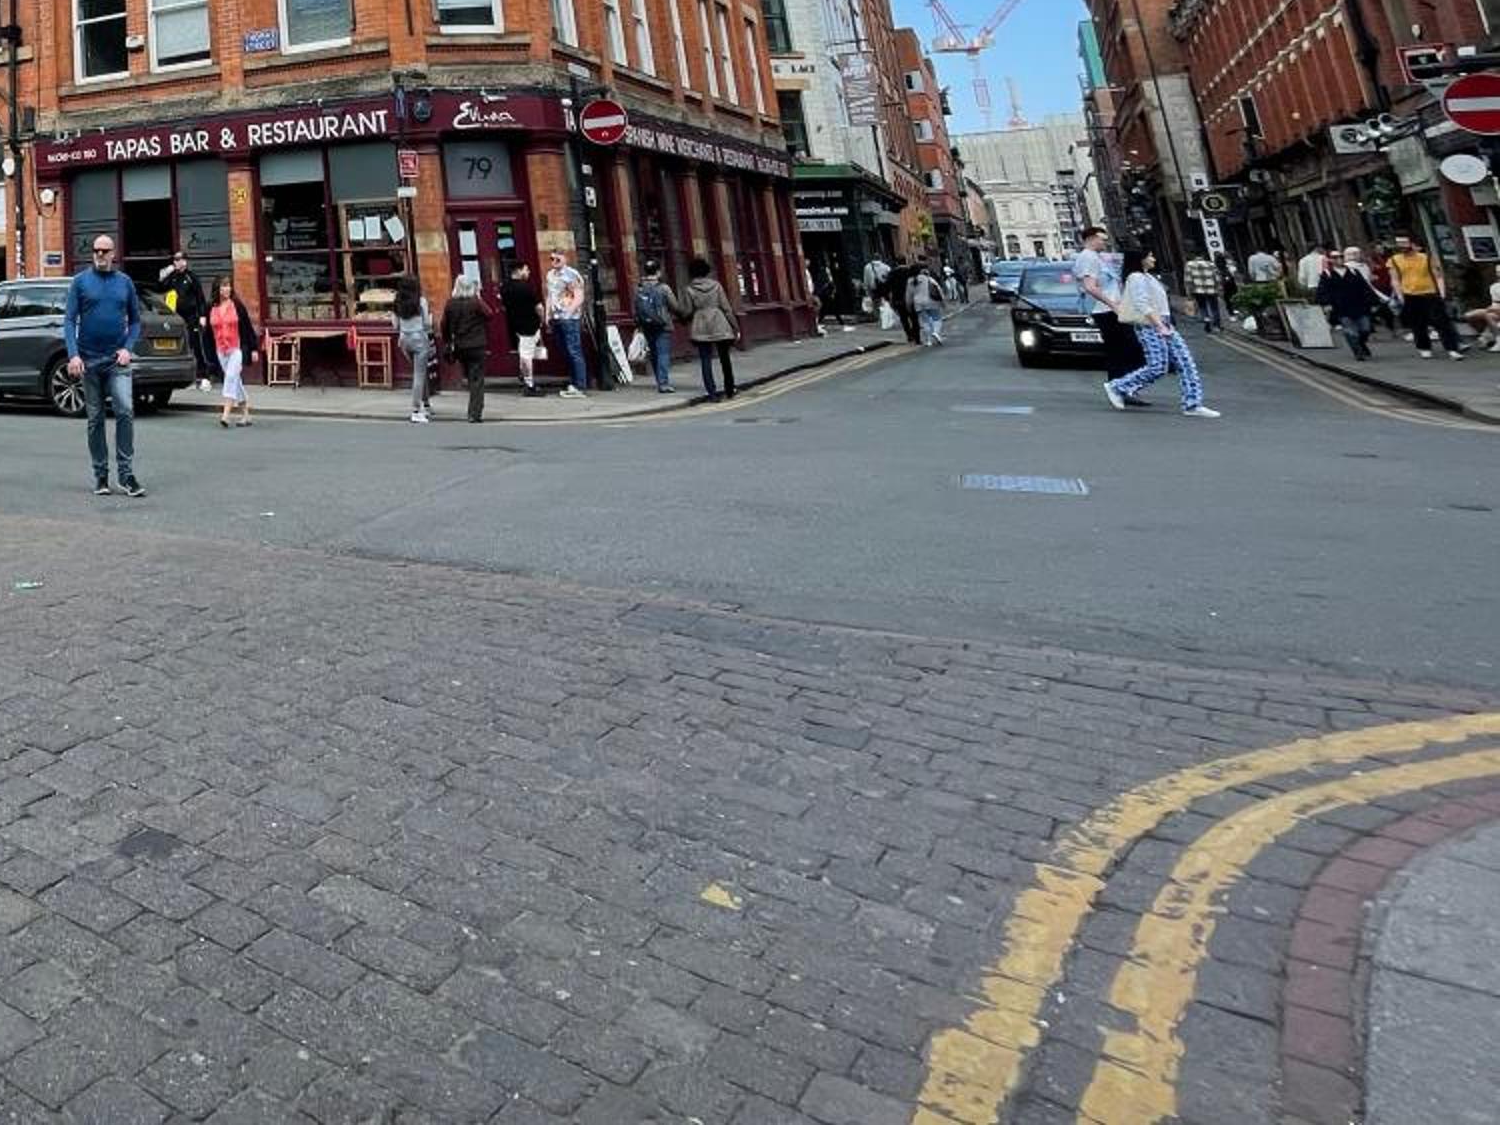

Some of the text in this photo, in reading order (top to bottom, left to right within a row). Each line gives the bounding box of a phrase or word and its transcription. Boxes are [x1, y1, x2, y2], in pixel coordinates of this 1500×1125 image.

[105, 135, 161, 161] TAPAS
[170, 131, 209, 155] BAR
[220, 128, 237, 149] &
[248, 110, 389, 147] RESTAURANT
[464, 156, 493, 180] 79
